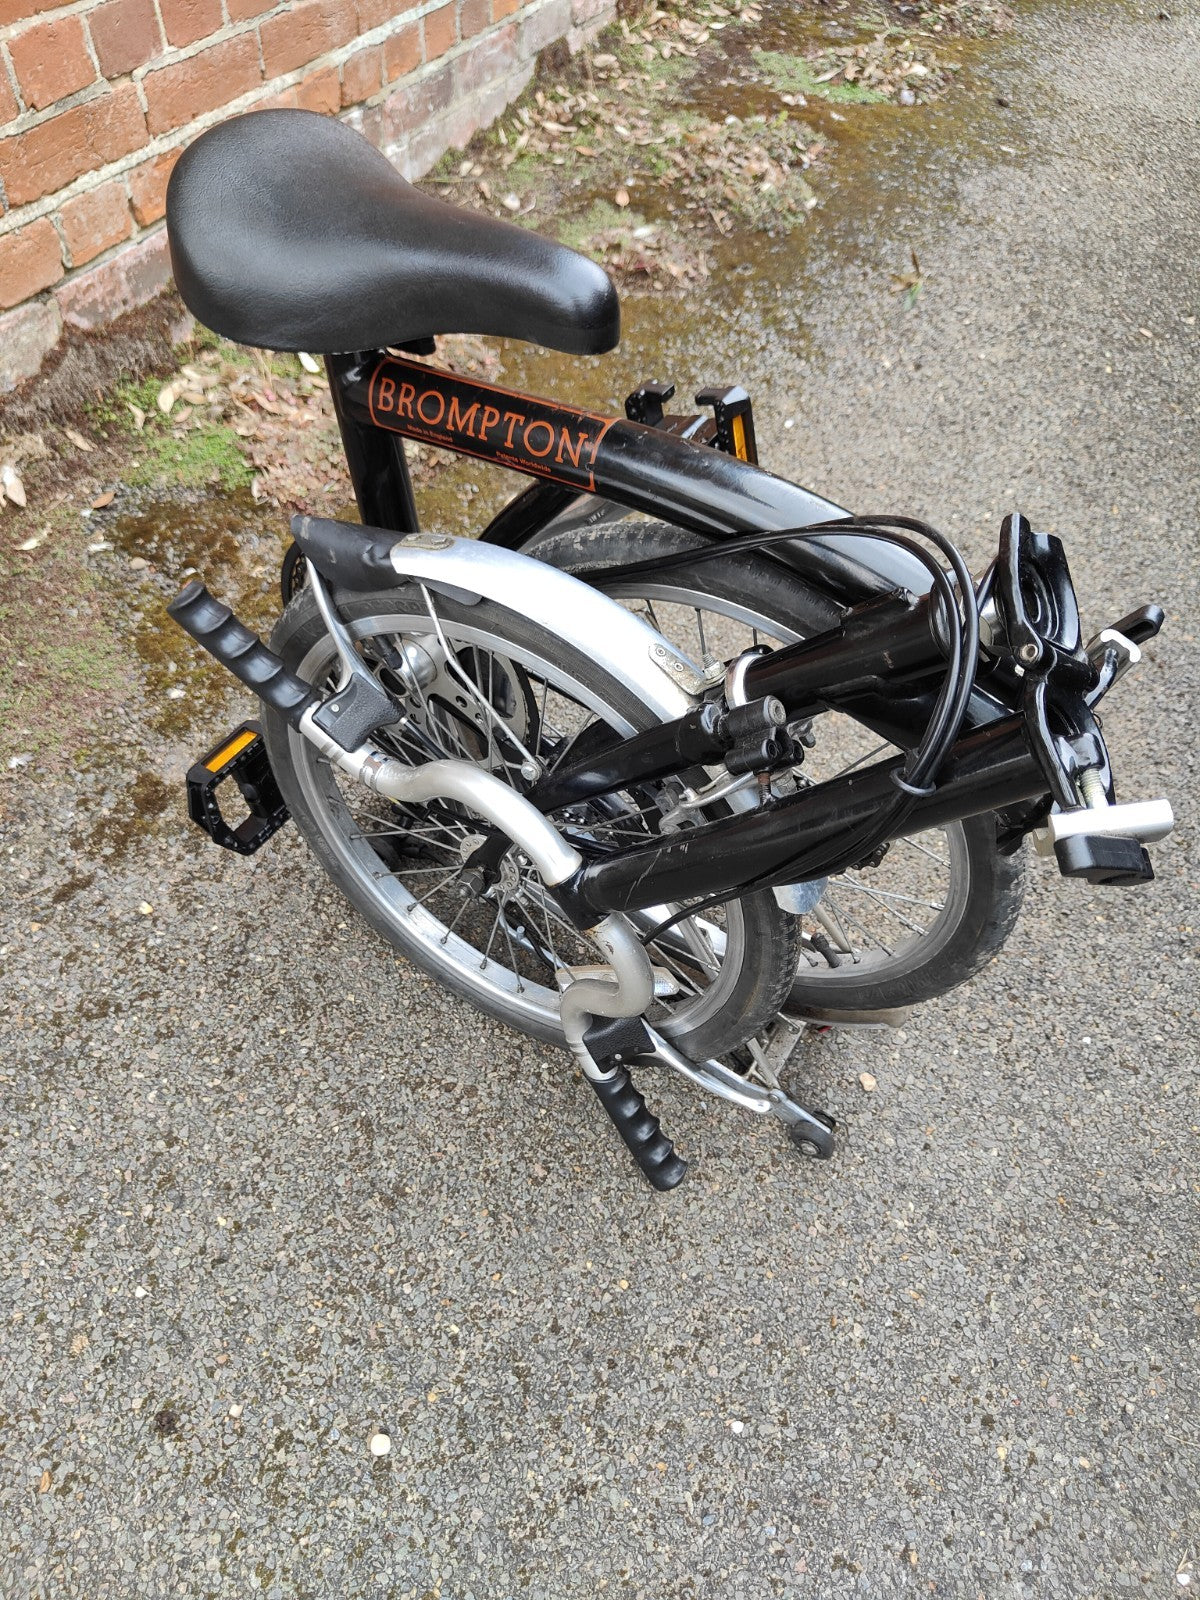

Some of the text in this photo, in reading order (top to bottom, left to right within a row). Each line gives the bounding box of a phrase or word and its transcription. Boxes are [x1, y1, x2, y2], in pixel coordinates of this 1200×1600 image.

[377, 377, 589, 467] BROMPTON
[407, 424, 422, 433] Made
[519, 458, 551, 473] Worldwide
